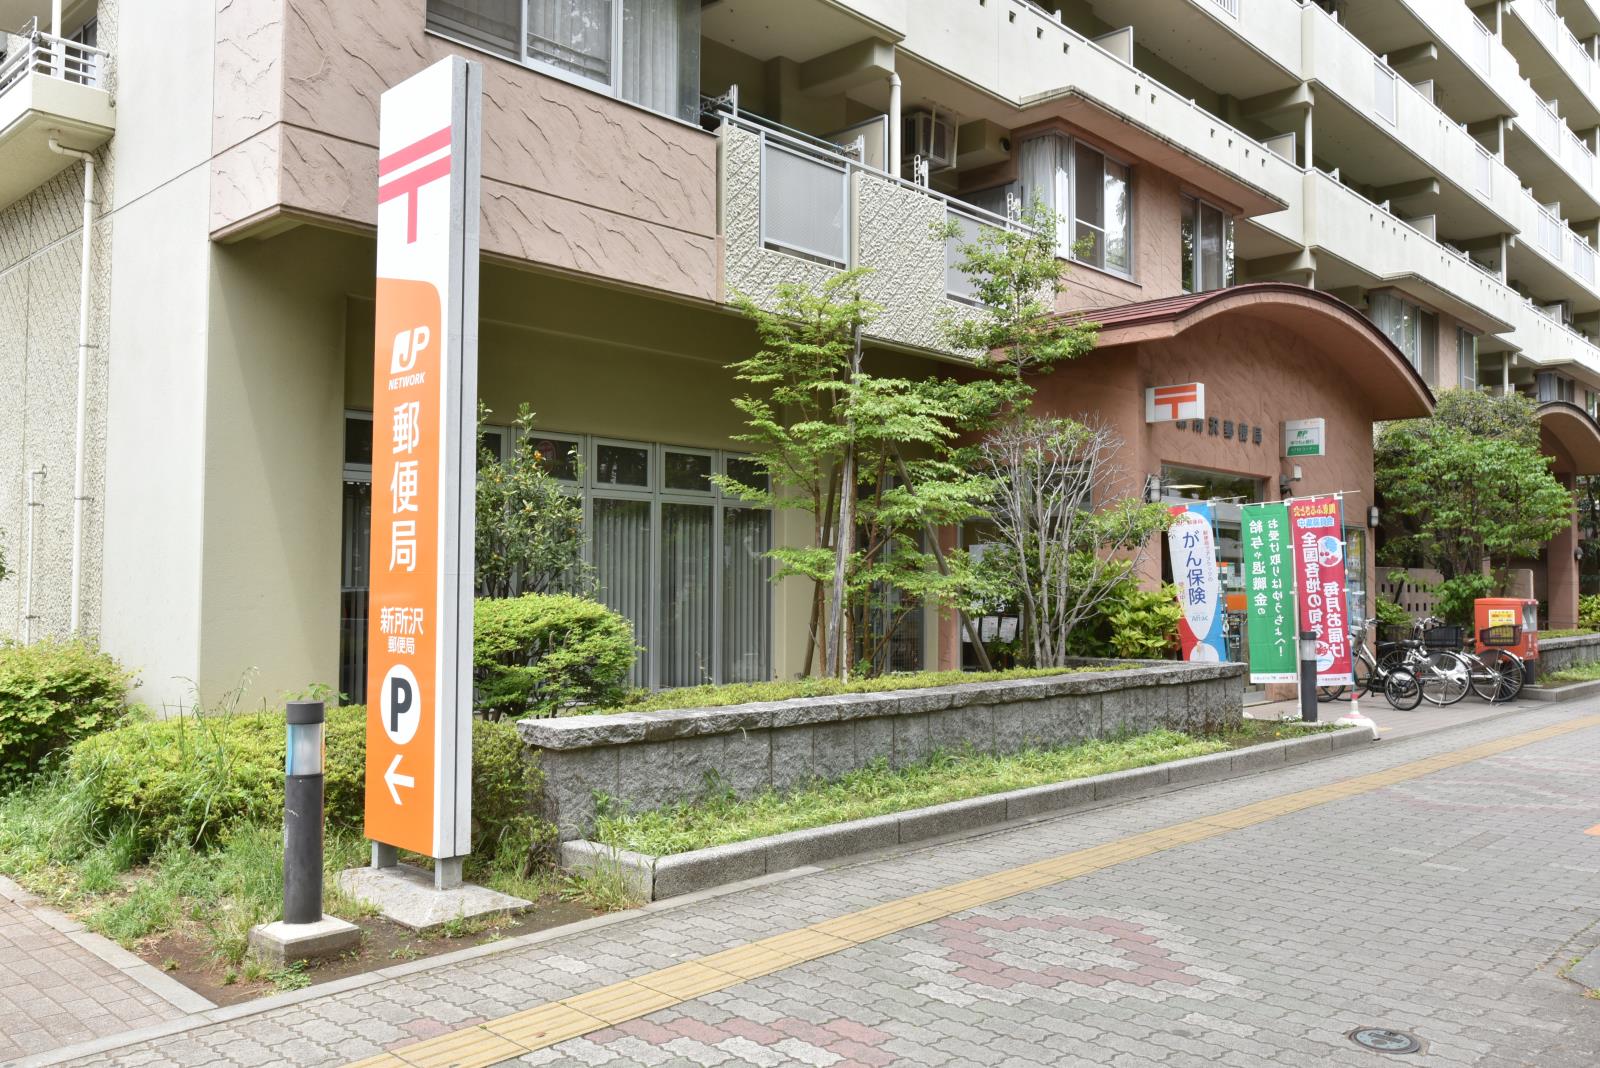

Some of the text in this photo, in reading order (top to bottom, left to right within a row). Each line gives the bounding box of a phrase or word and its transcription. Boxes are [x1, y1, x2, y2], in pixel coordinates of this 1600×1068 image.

[390, 325, 430, 374] JP
[388, 372, 426, 391] NETWORK
[389, 401, 420, 573] 郵便局
[1183, 531, 1206, 606] がん保険
[380, 606, 424, 635] 新所沢
[388, 636, 415, 656] 郵便局
[390, 677, 412, 733] P
